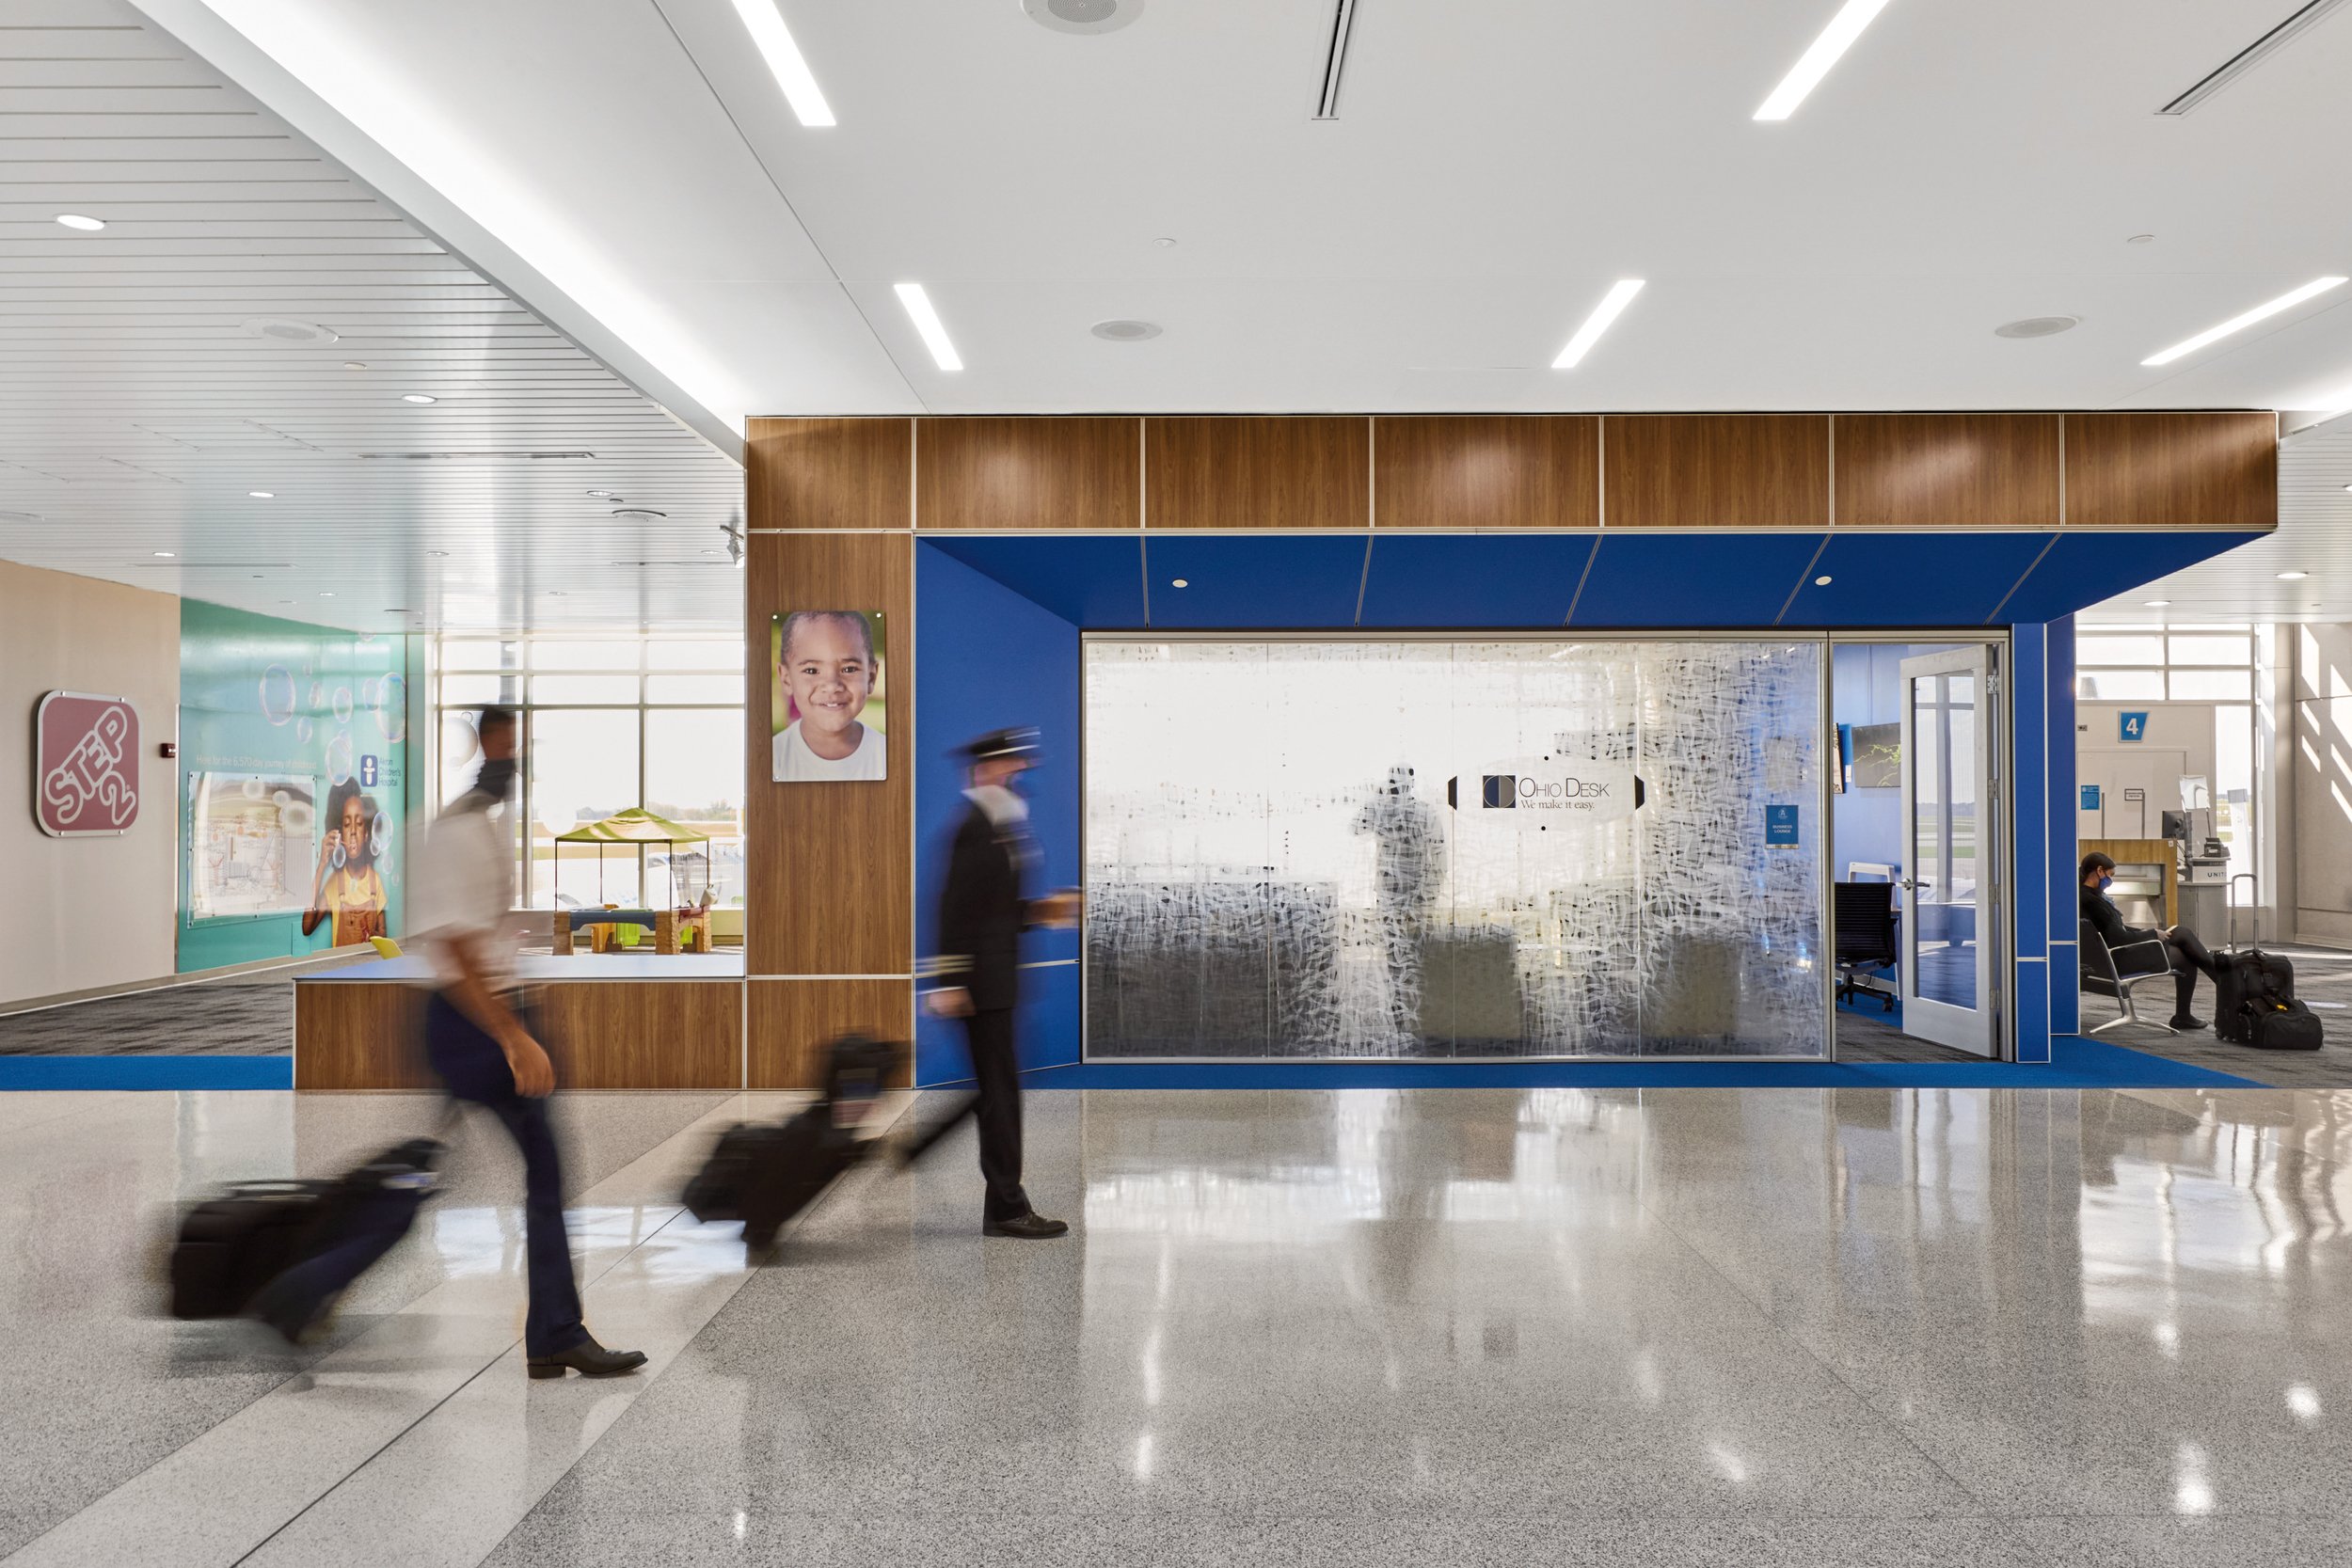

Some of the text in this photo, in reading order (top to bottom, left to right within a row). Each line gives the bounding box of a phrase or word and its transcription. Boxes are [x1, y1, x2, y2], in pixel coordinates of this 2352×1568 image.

[2126, 718, 2138, 735] 4
[45, 705, 127, 824] STEP
[99, 769, 136, 825] 2
[1520, 799, 1596, 811] We make it easy.
